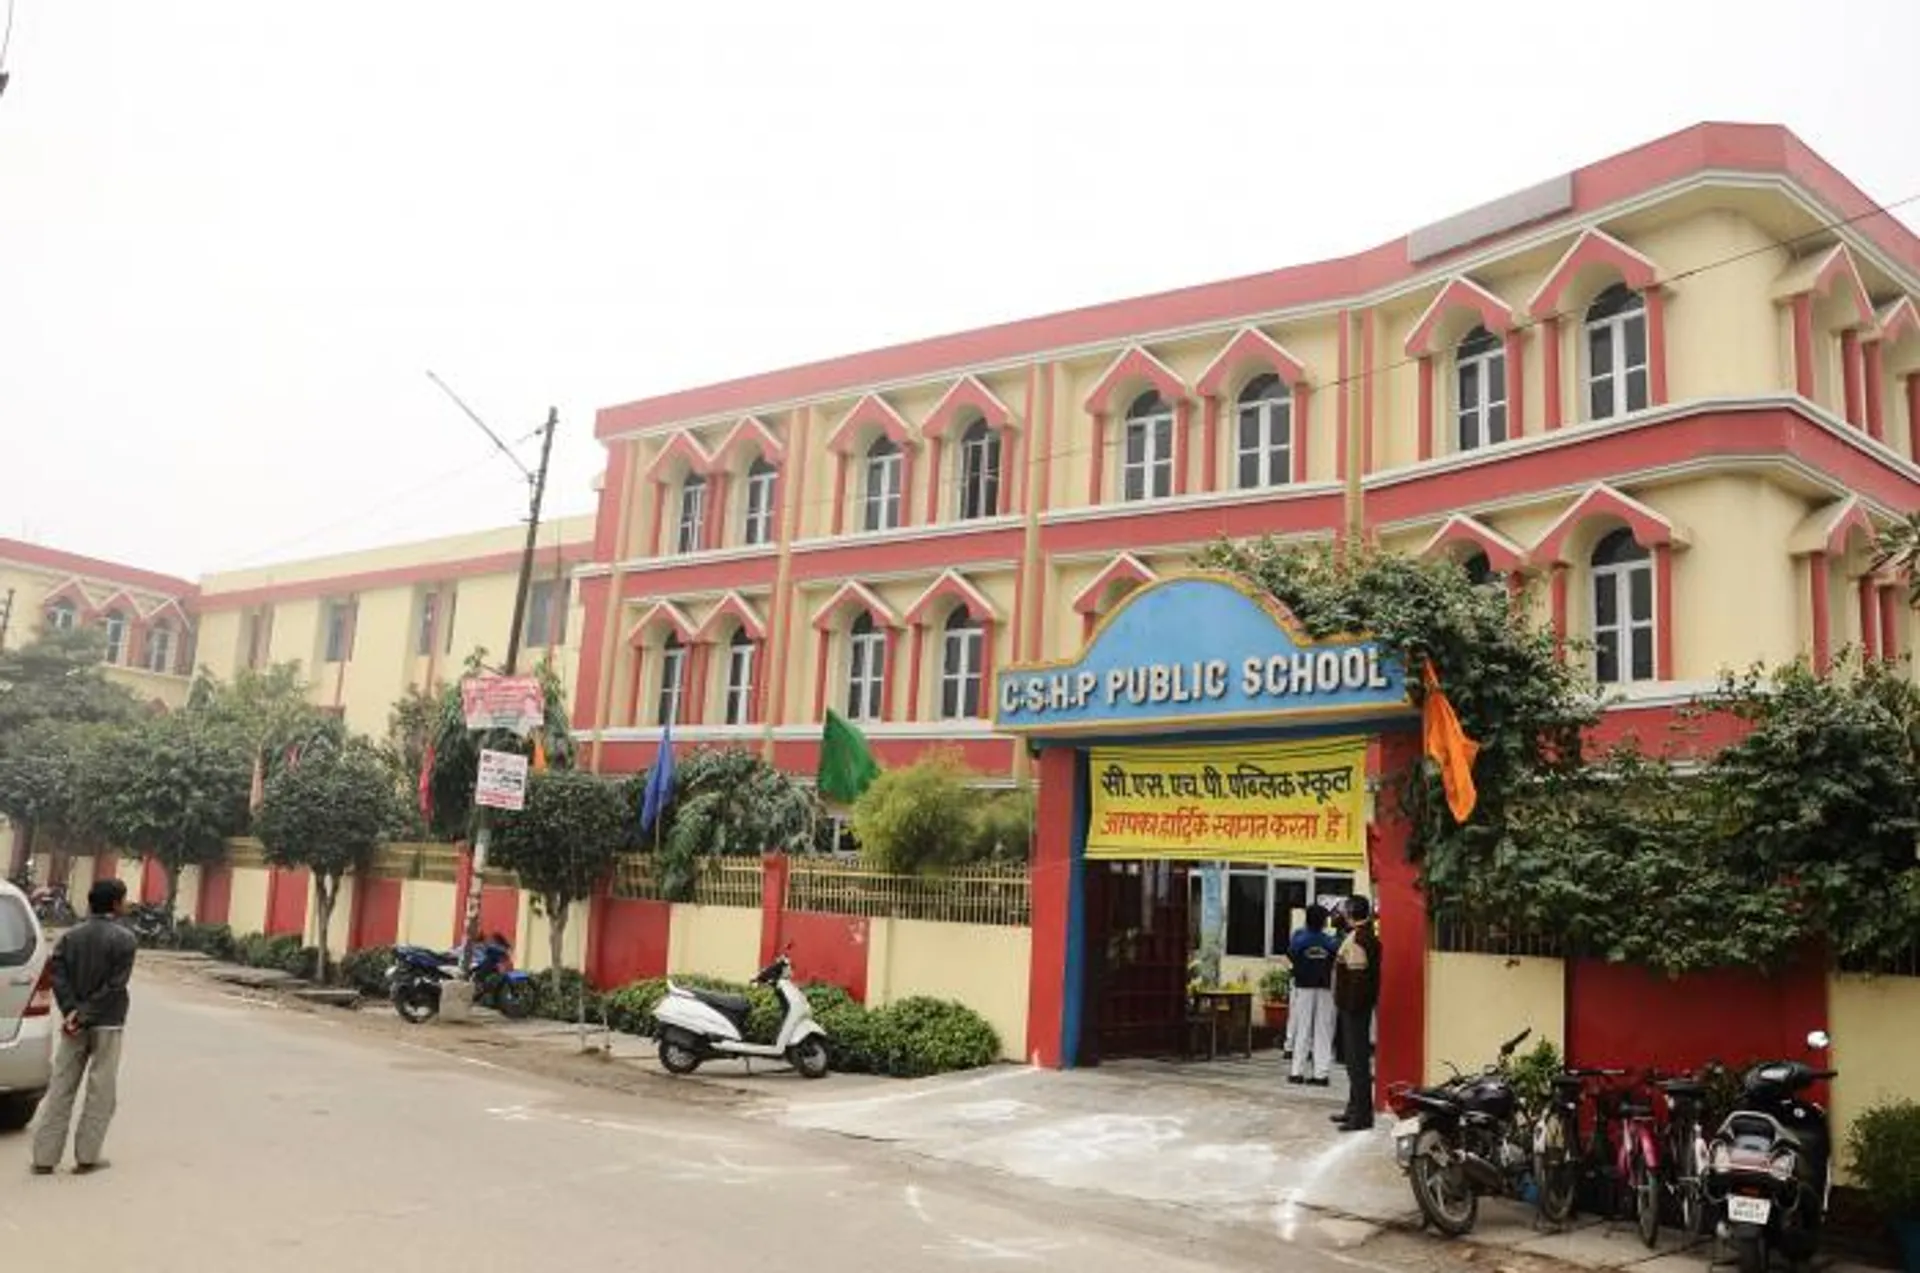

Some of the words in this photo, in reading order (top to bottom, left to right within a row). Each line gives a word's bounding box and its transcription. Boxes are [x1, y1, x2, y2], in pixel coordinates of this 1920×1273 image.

[1106, 659, 1227, 704] PUBLIC
[1242, 647, 1388, 695] SCHOOL
[1295, 765, 1353, 805] स्कूल
